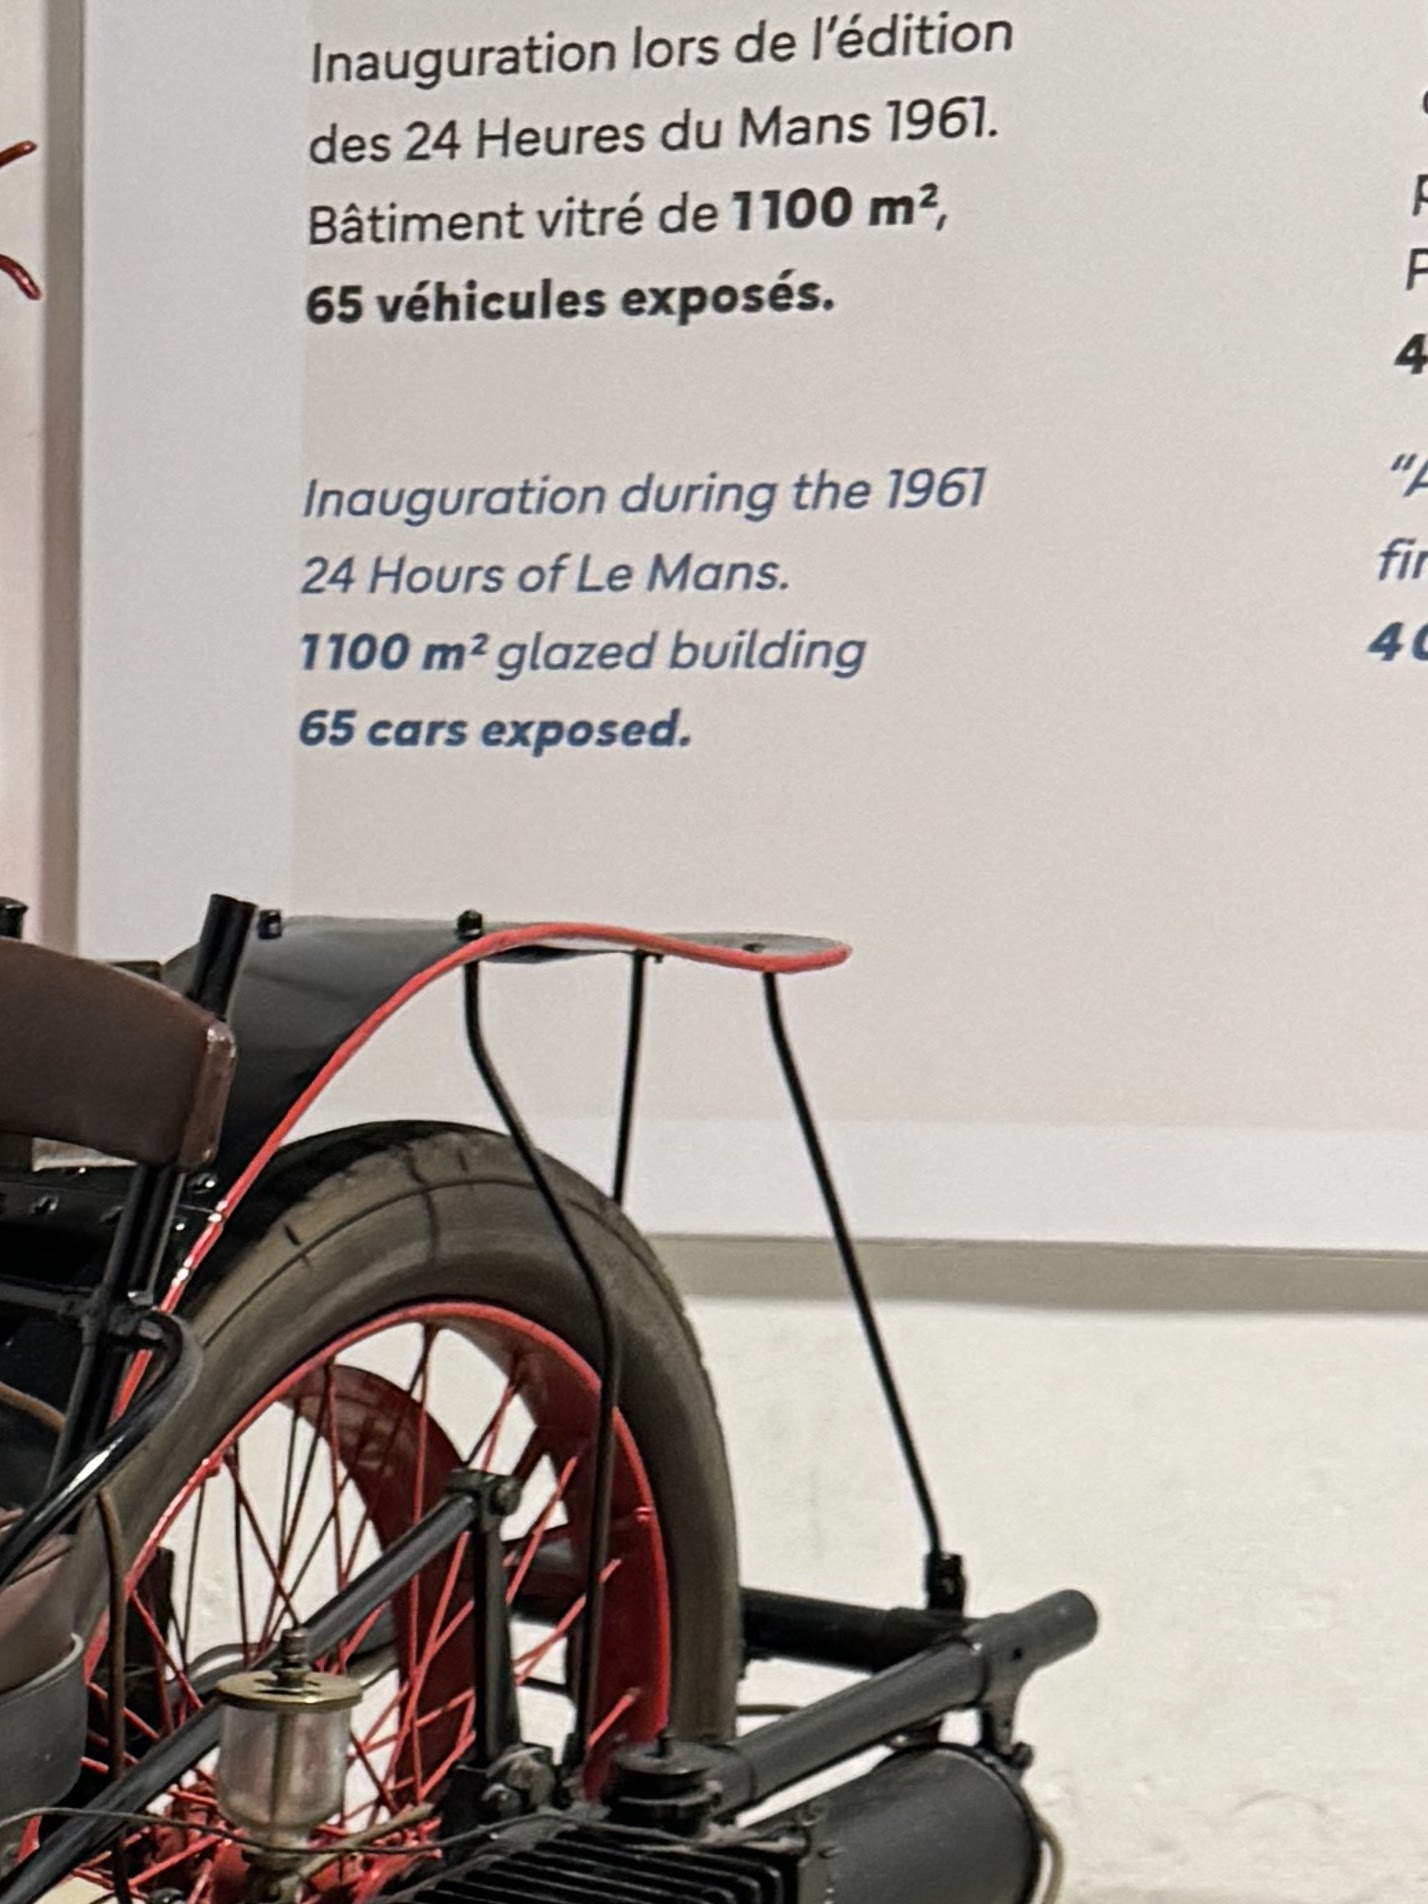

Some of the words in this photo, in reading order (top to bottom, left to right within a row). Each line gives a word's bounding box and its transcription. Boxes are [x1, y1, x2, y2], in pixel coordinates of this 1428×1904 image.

[312, 30, 617, 91] Inauguration
[631, 25, 721, 72] lors
[734, 18, 797, 64] de
[308, 121, 393, 165] des
[402, 118, 463, 162] 24
[475, 116, 646, 160] Heures
[658, 107, 723, 152] du
[738, 104, 872, 148] Mans
[884, 95, 999, 143] 1961.
[307, 200, 527, 252] Bâtiment
[535, 190, 645, 239] vitré
[657, 190, 720, 234] de
[730, 186, 854, 232] 1100
[866, 181, 948, 233] m²,
[305, 283, 365, 326] 65
[375, 276, 609, 324] véhicules
[619, 267, 836, 328] exposés.
[301, 473, 608, 528] Inauguration
[620, 471, 780, 523] during
[792, 467, 873, 511] the
[887, 465, 989, 510] 1961
[299, 553, 357, 595] 24
[367, 552, 507, 596] Hours
[516, 551, 573, 594] of
[575, 552, 635, 593] Le
[645, 551, 790, 592] Mans.
[300, 631, 413, 672] 1100
[421, 631, 491, 672] m²
[495, 629, 661, 682] glazed
[667, 628, 869, 680] building
[297, 708, 358, 748] 65
[366, 718, 469, 748] cars
[480, 707, 692, 759] exposed.
